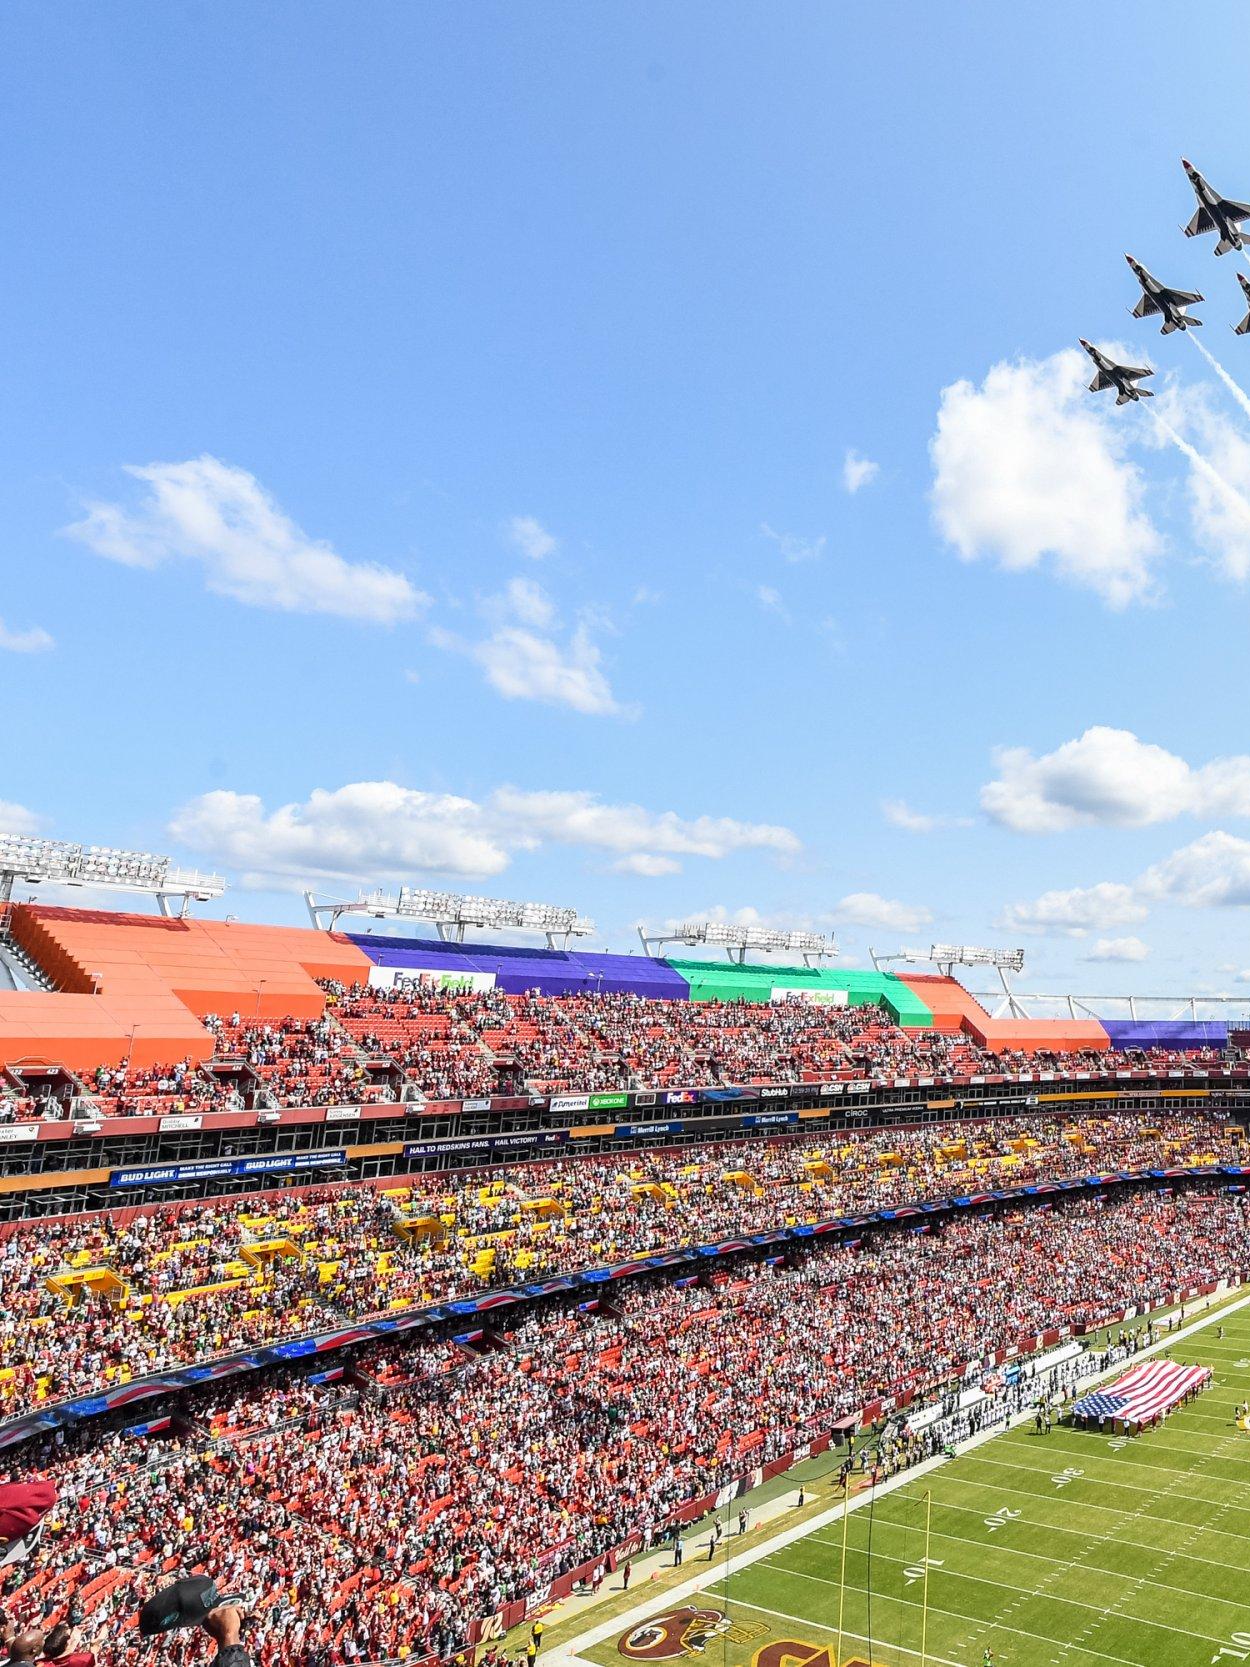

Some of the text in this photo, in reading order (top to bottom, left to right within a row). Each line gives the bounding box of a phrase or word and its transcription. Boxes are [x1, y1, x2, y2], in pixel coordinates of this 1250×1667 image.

[666, 1092, 694, 1103] FedEx
[761, 1088, 788, 1097] StubHub
[655, 1124, 669, 1133] Lynch
[437, 1142, 471, 1152] REDSKINS
[509, 1136, 538, 1145] VICTORY!
[246, 1158, 293, 1170] BUD LIGHT
[120, 1170, 175, 1182] BUD LIGHT
[1051, 1467, 1085, 1484] 30
[983, 1506, 1022, 1526] 20
[902, 1557, 946, 1578] 10
